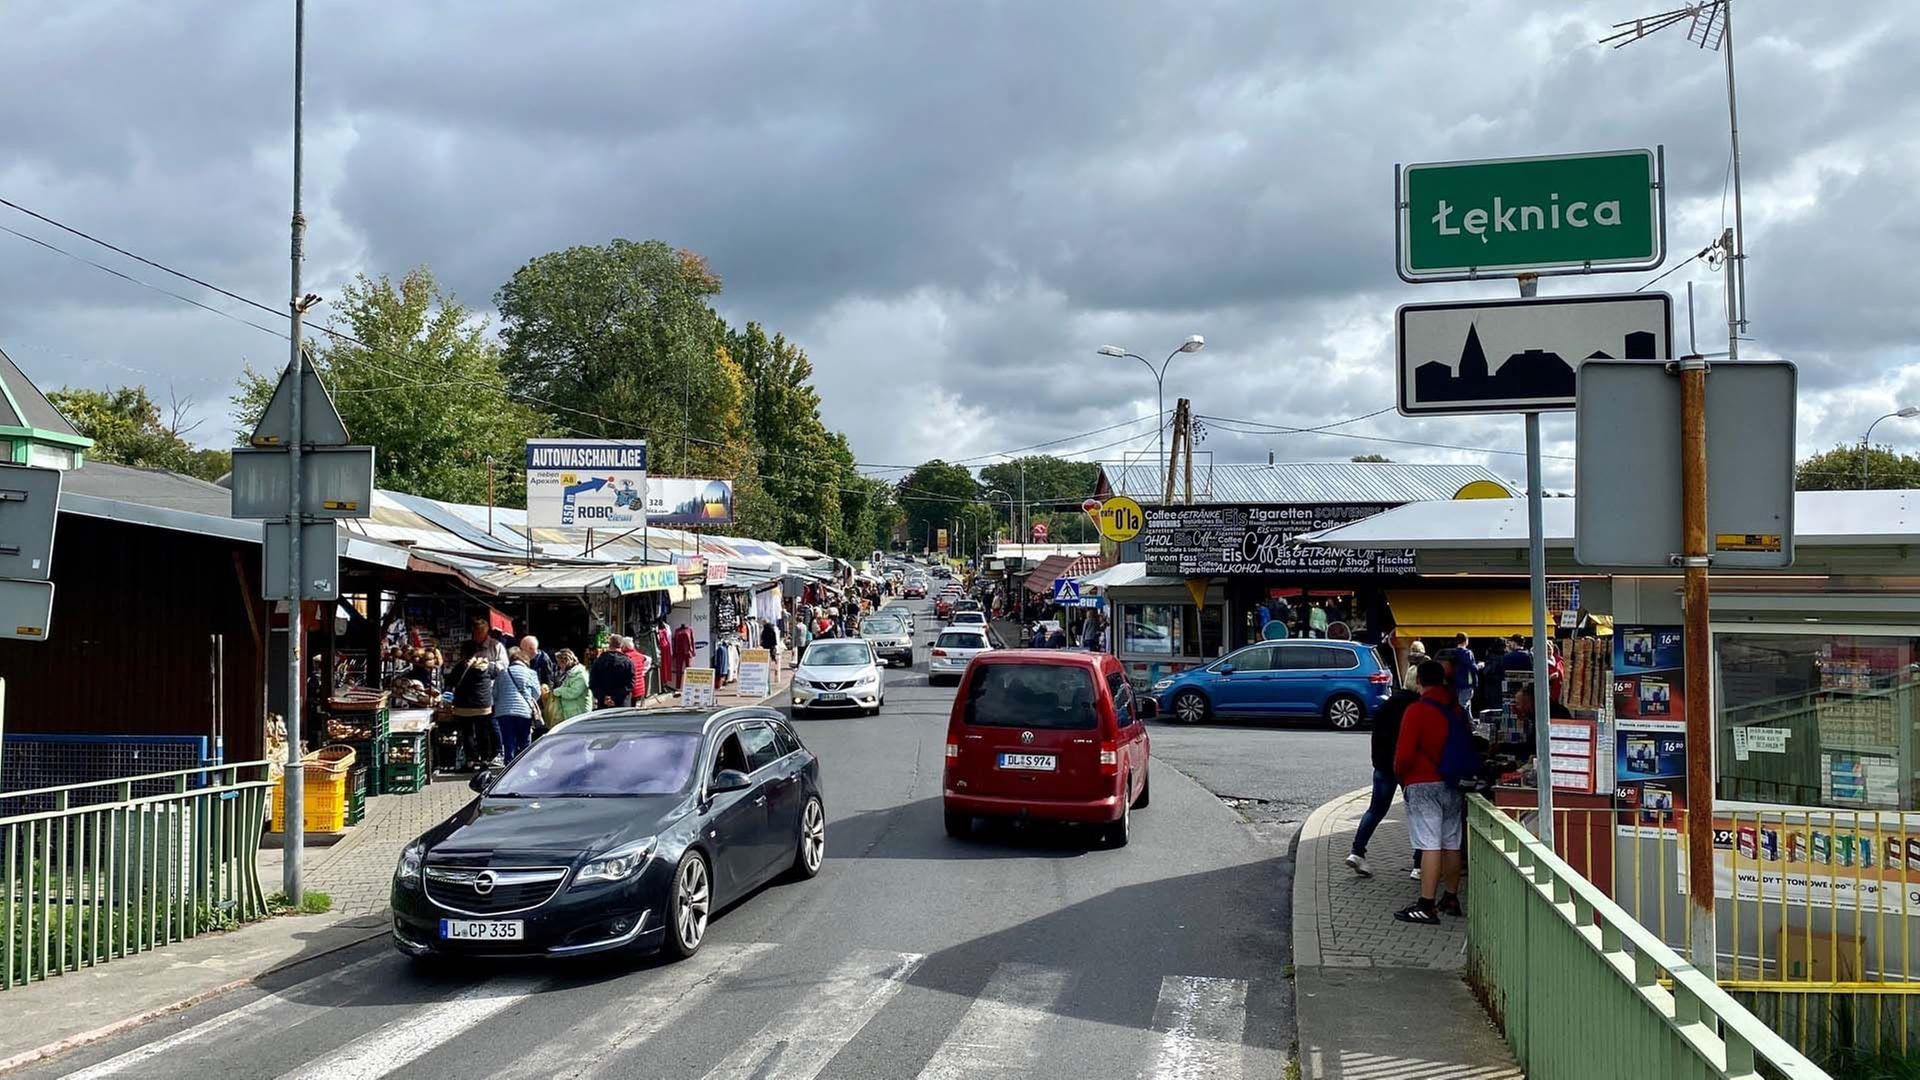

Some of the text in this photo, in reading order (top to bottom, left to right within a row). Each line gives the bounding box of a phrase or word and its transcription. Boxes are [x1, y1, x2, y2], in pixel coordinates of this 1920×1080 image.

[1432, 193, 1622, 243] Łęknica
[532, 448, 641, 467] AUTOWASCHANLAGE
[530, 478, 559, 486] Apexim
[563, 494, 575, 524] 350 m
[578, 506, 612, 518] ROBO
[1145, 509, 1221, 520] Coffee GETRÄNKE
[1249, 508, 1313, 521] Zigaretten
[1222, 508, 1248, 527] Eis
[1223, 548, 1242, 562] Eis
[1377, 556, 1413, 564] Frisches
[1274, 558, 1297, 566] Cafe
[1299, 558, 1306, 566] &
[1308, 558, 1337, 566] Laden
[1346, 557, 1370, 567] Shop
[1180, 566, 1216, 574] Zigaretten
[1216, 563, 1263, 573] ALKOHOL
[1377, 565, 1417, 575] Hausgem
[1008, 755, 1051, 766] DL S 974
[452, 923, 517, 937] L CP 335
